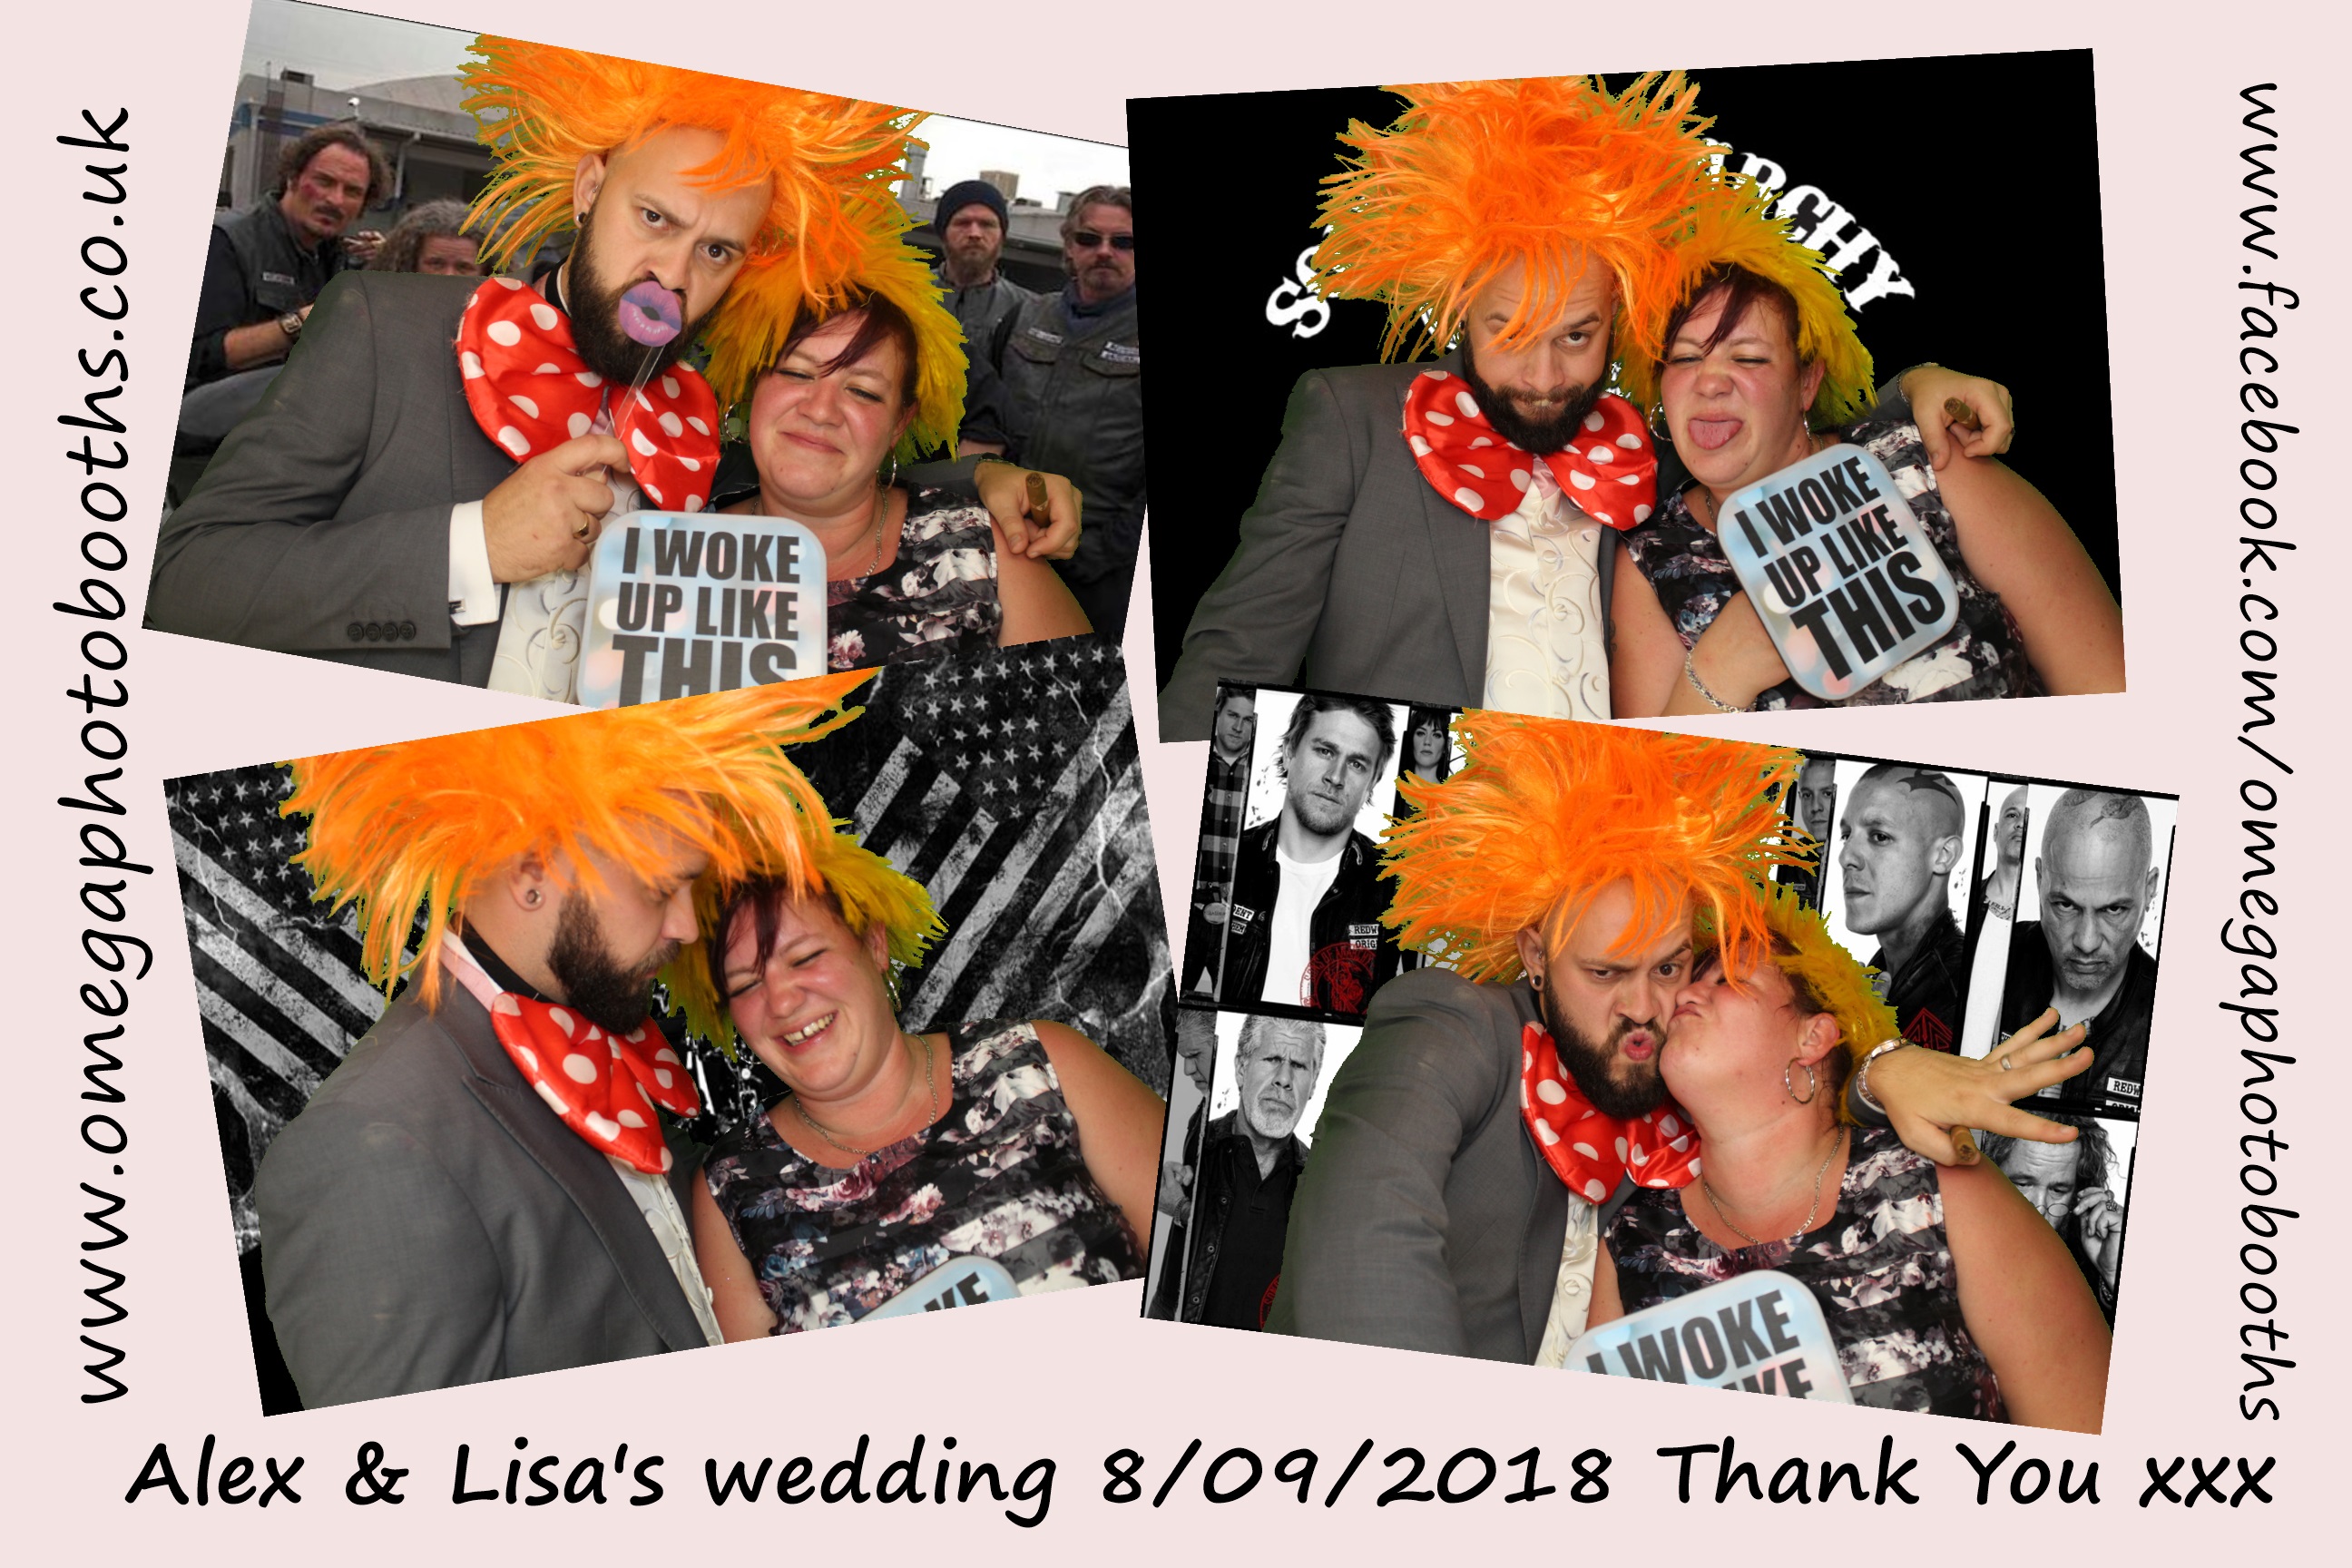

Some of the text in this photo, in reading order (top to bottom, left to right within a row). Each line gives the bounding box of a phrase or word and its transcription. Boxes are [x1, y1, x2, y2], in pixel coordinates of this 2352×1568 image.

[622, 527, 800, 583] I WOKE
[1734, 456, 1880, 558] I WOKE
[1764, 504, 1908, 607] UP LIKE
[616, 582, 798, 641] UP LIKE
[1790, 551, 1945, 681] THIS
